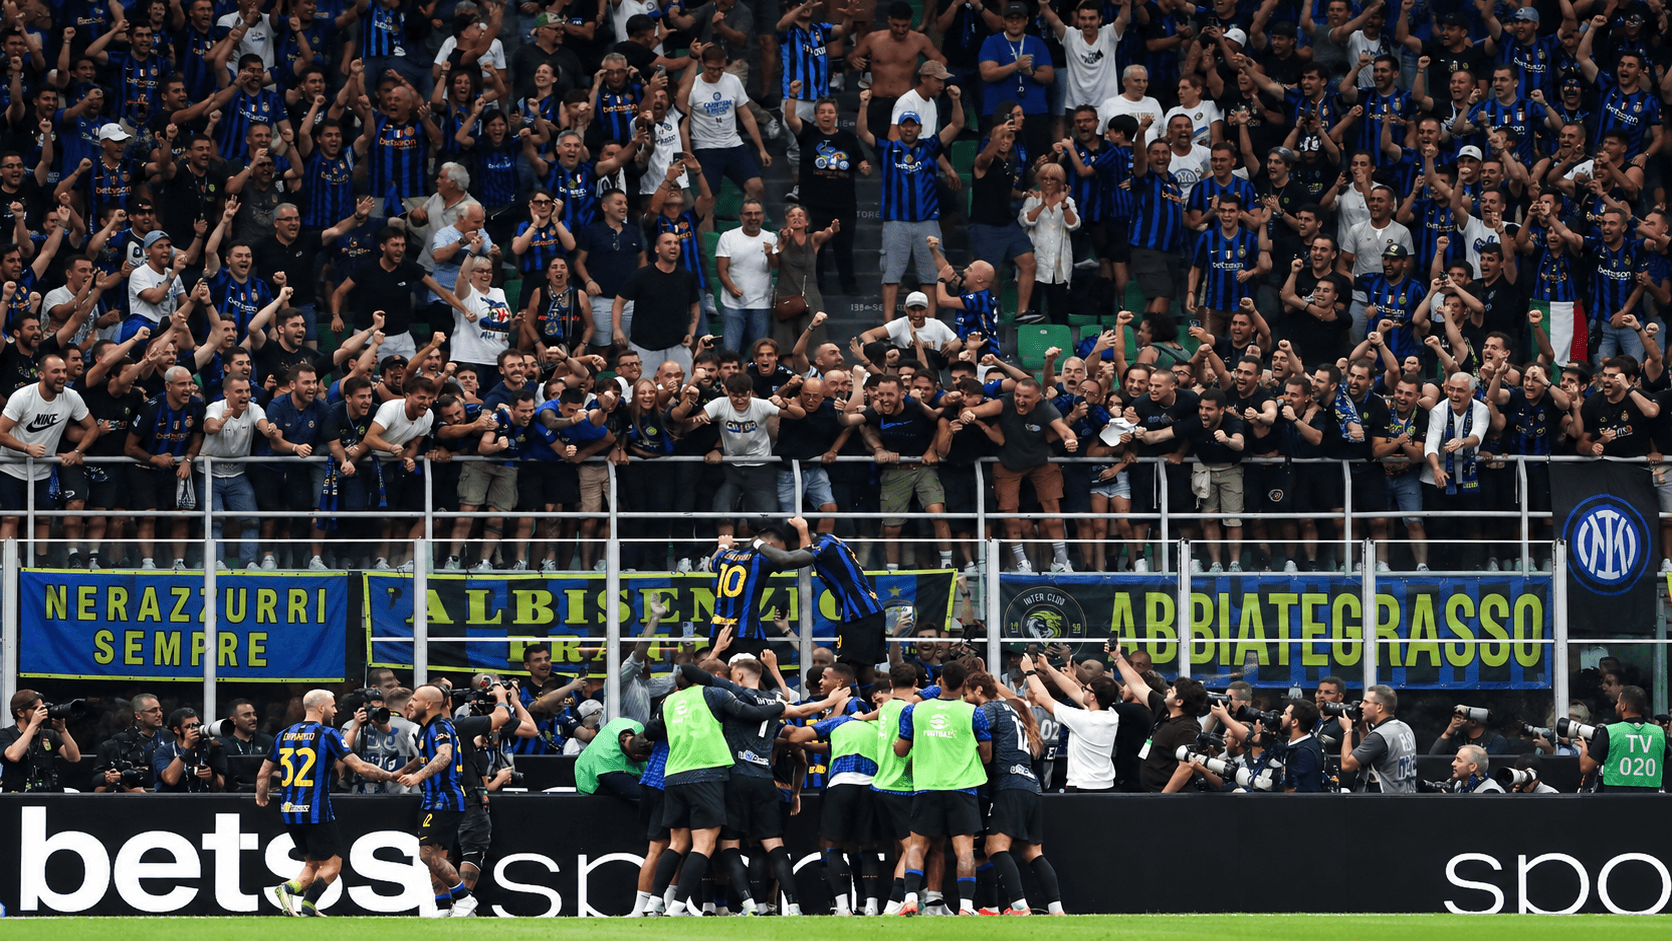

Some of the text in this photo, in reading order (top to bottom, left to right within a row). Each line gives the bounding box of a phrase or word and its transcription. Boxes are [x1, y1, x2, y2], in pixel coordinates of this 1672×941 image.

[34, 413, 58, 425] NIKE
[717, 563, 749, 598] 10
[45, 584, 327, 624] NERAZURRI
[1107, 592, 1544, 668] ABBIATEGRASSO
[93, 630, 269, 667] SEMPRE
[1626, 733, 1652, 753] TV
[279, 747, 316, 787] 32
[1619, 757, 1656, 777] 020
